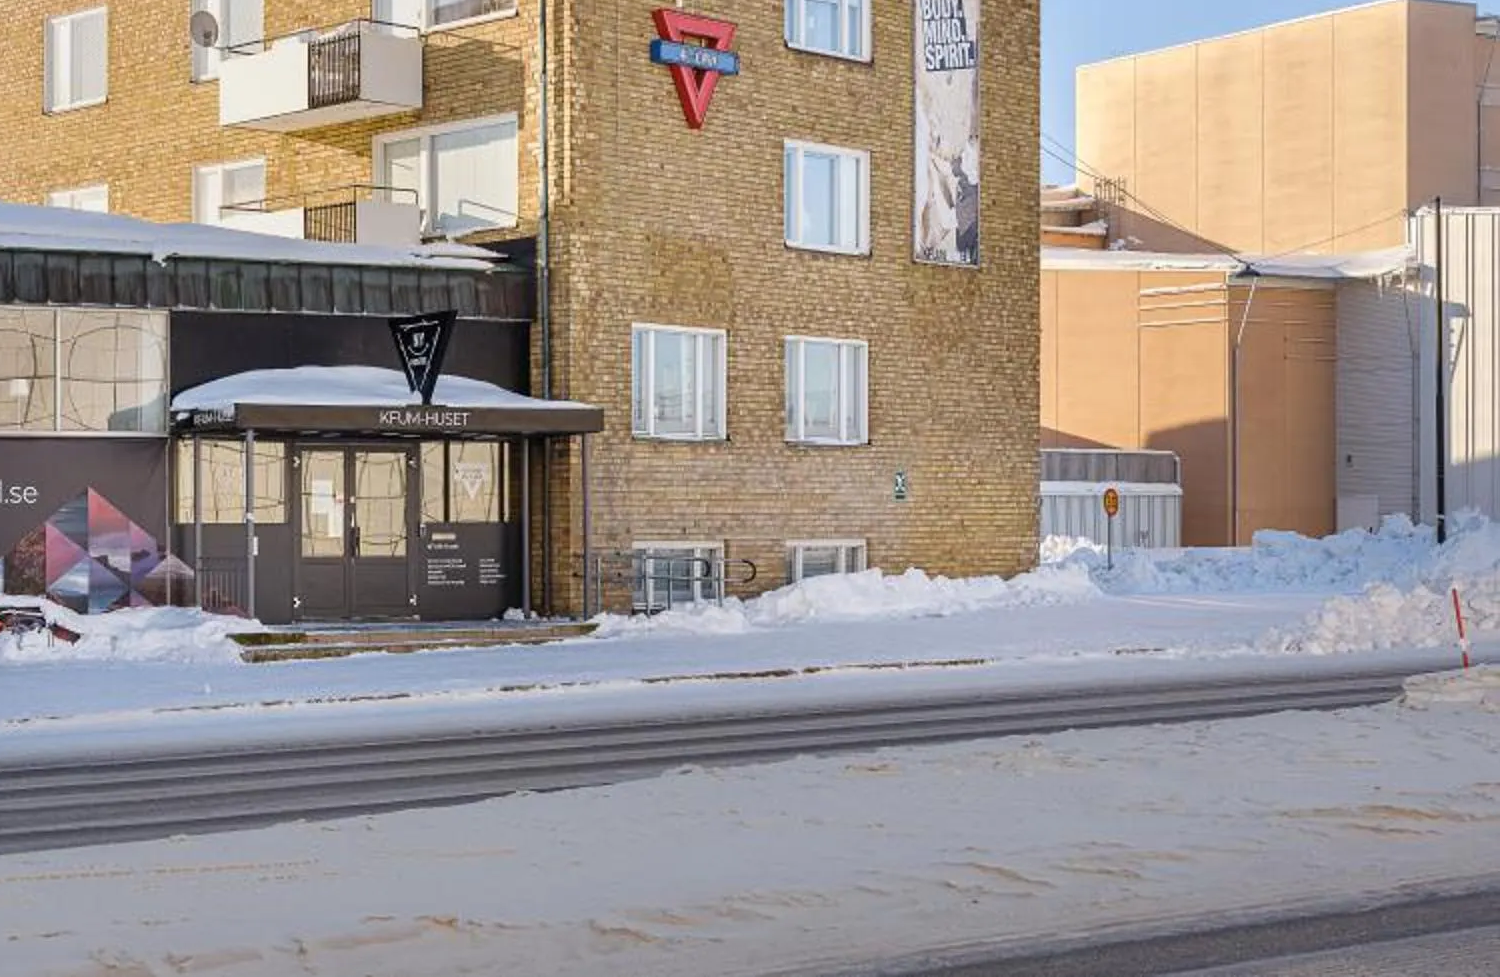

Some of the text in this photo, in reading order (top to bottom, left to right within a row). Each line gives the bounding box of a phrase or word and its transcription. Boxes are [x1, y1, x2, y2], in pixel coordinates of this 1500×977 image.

[923, 18, 965, 44] MIND.
[925, 42, 975, 71] SPIRIT.
[379, 410, 471, 427] KFUM-HUSET
